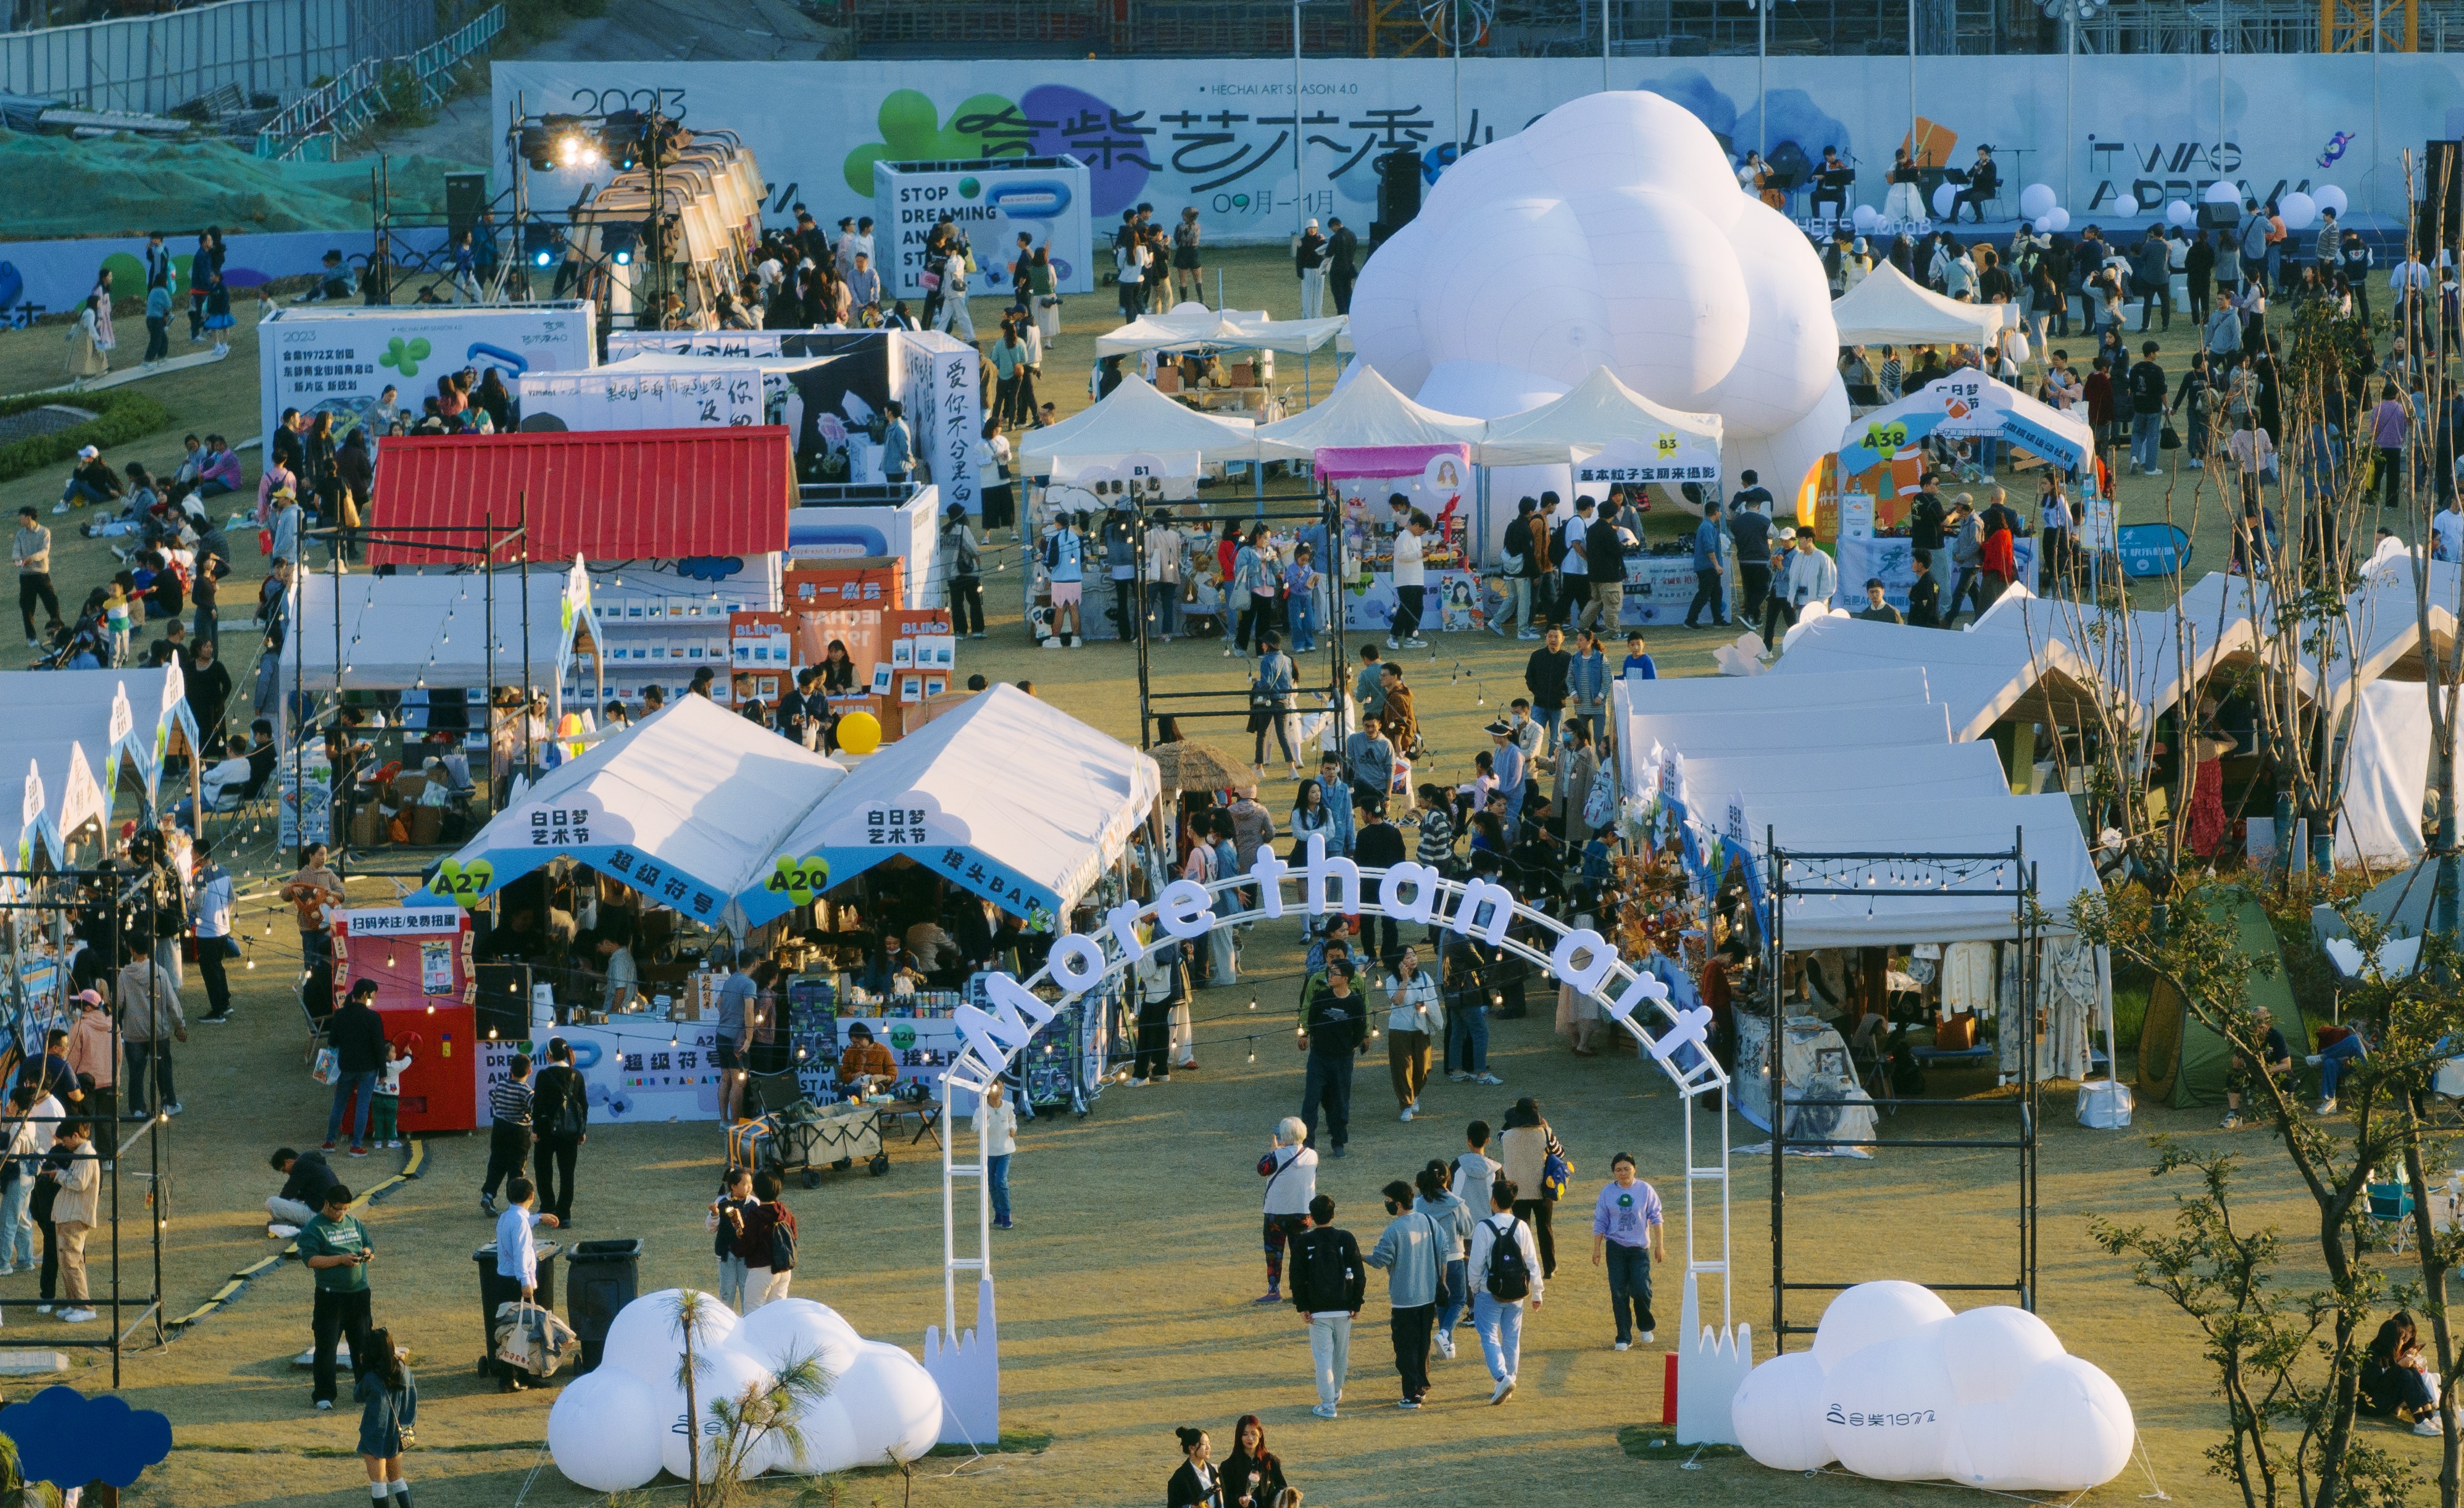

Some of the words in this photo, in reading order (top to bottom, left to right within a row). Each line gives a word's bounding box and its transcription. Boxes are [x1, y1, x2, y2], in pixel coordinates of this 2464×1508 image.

[1212, 84, 1257, 94] HECHAI
[1262, 84, 1283, 94] ART
[1339, 83, 1357, 94] 4.0
[2133, 143, 2242, 173] WAS
[901, 186, 948, 202] STOP
[902, 206, 996, 223] DREAMING
[902, 230, 927, 244] AN
[1660, 439, 1677, 449] B3
[1863, 431, 1906, 448] A38
[1134, 466, 1149, 476] B1
[735, 623, 783, 636] BLIND
[902, 622, 949, 635] BLIND
[531, 809, 589, 826] 白日梦
[867, 809, 926, 826] 白日梦
[531, 828, 590, 845] 艺术节
[867, 828, 926, 844] 艺术节
[433, 873, 491, 894] A27
[607, 849, 715, 915] 超级符号
[769, 870, 828, 891] A20
[352, 914, 456, 930] 扫码关注/免费扭蛋
[953, 878, 1215, 1073] More
[1250, 833, 1514, 946] than
[1552, 928, 1713, 1062] art
[696, 1036, 715, 1046] A2
[891, 1031, 914, 1042] A20
